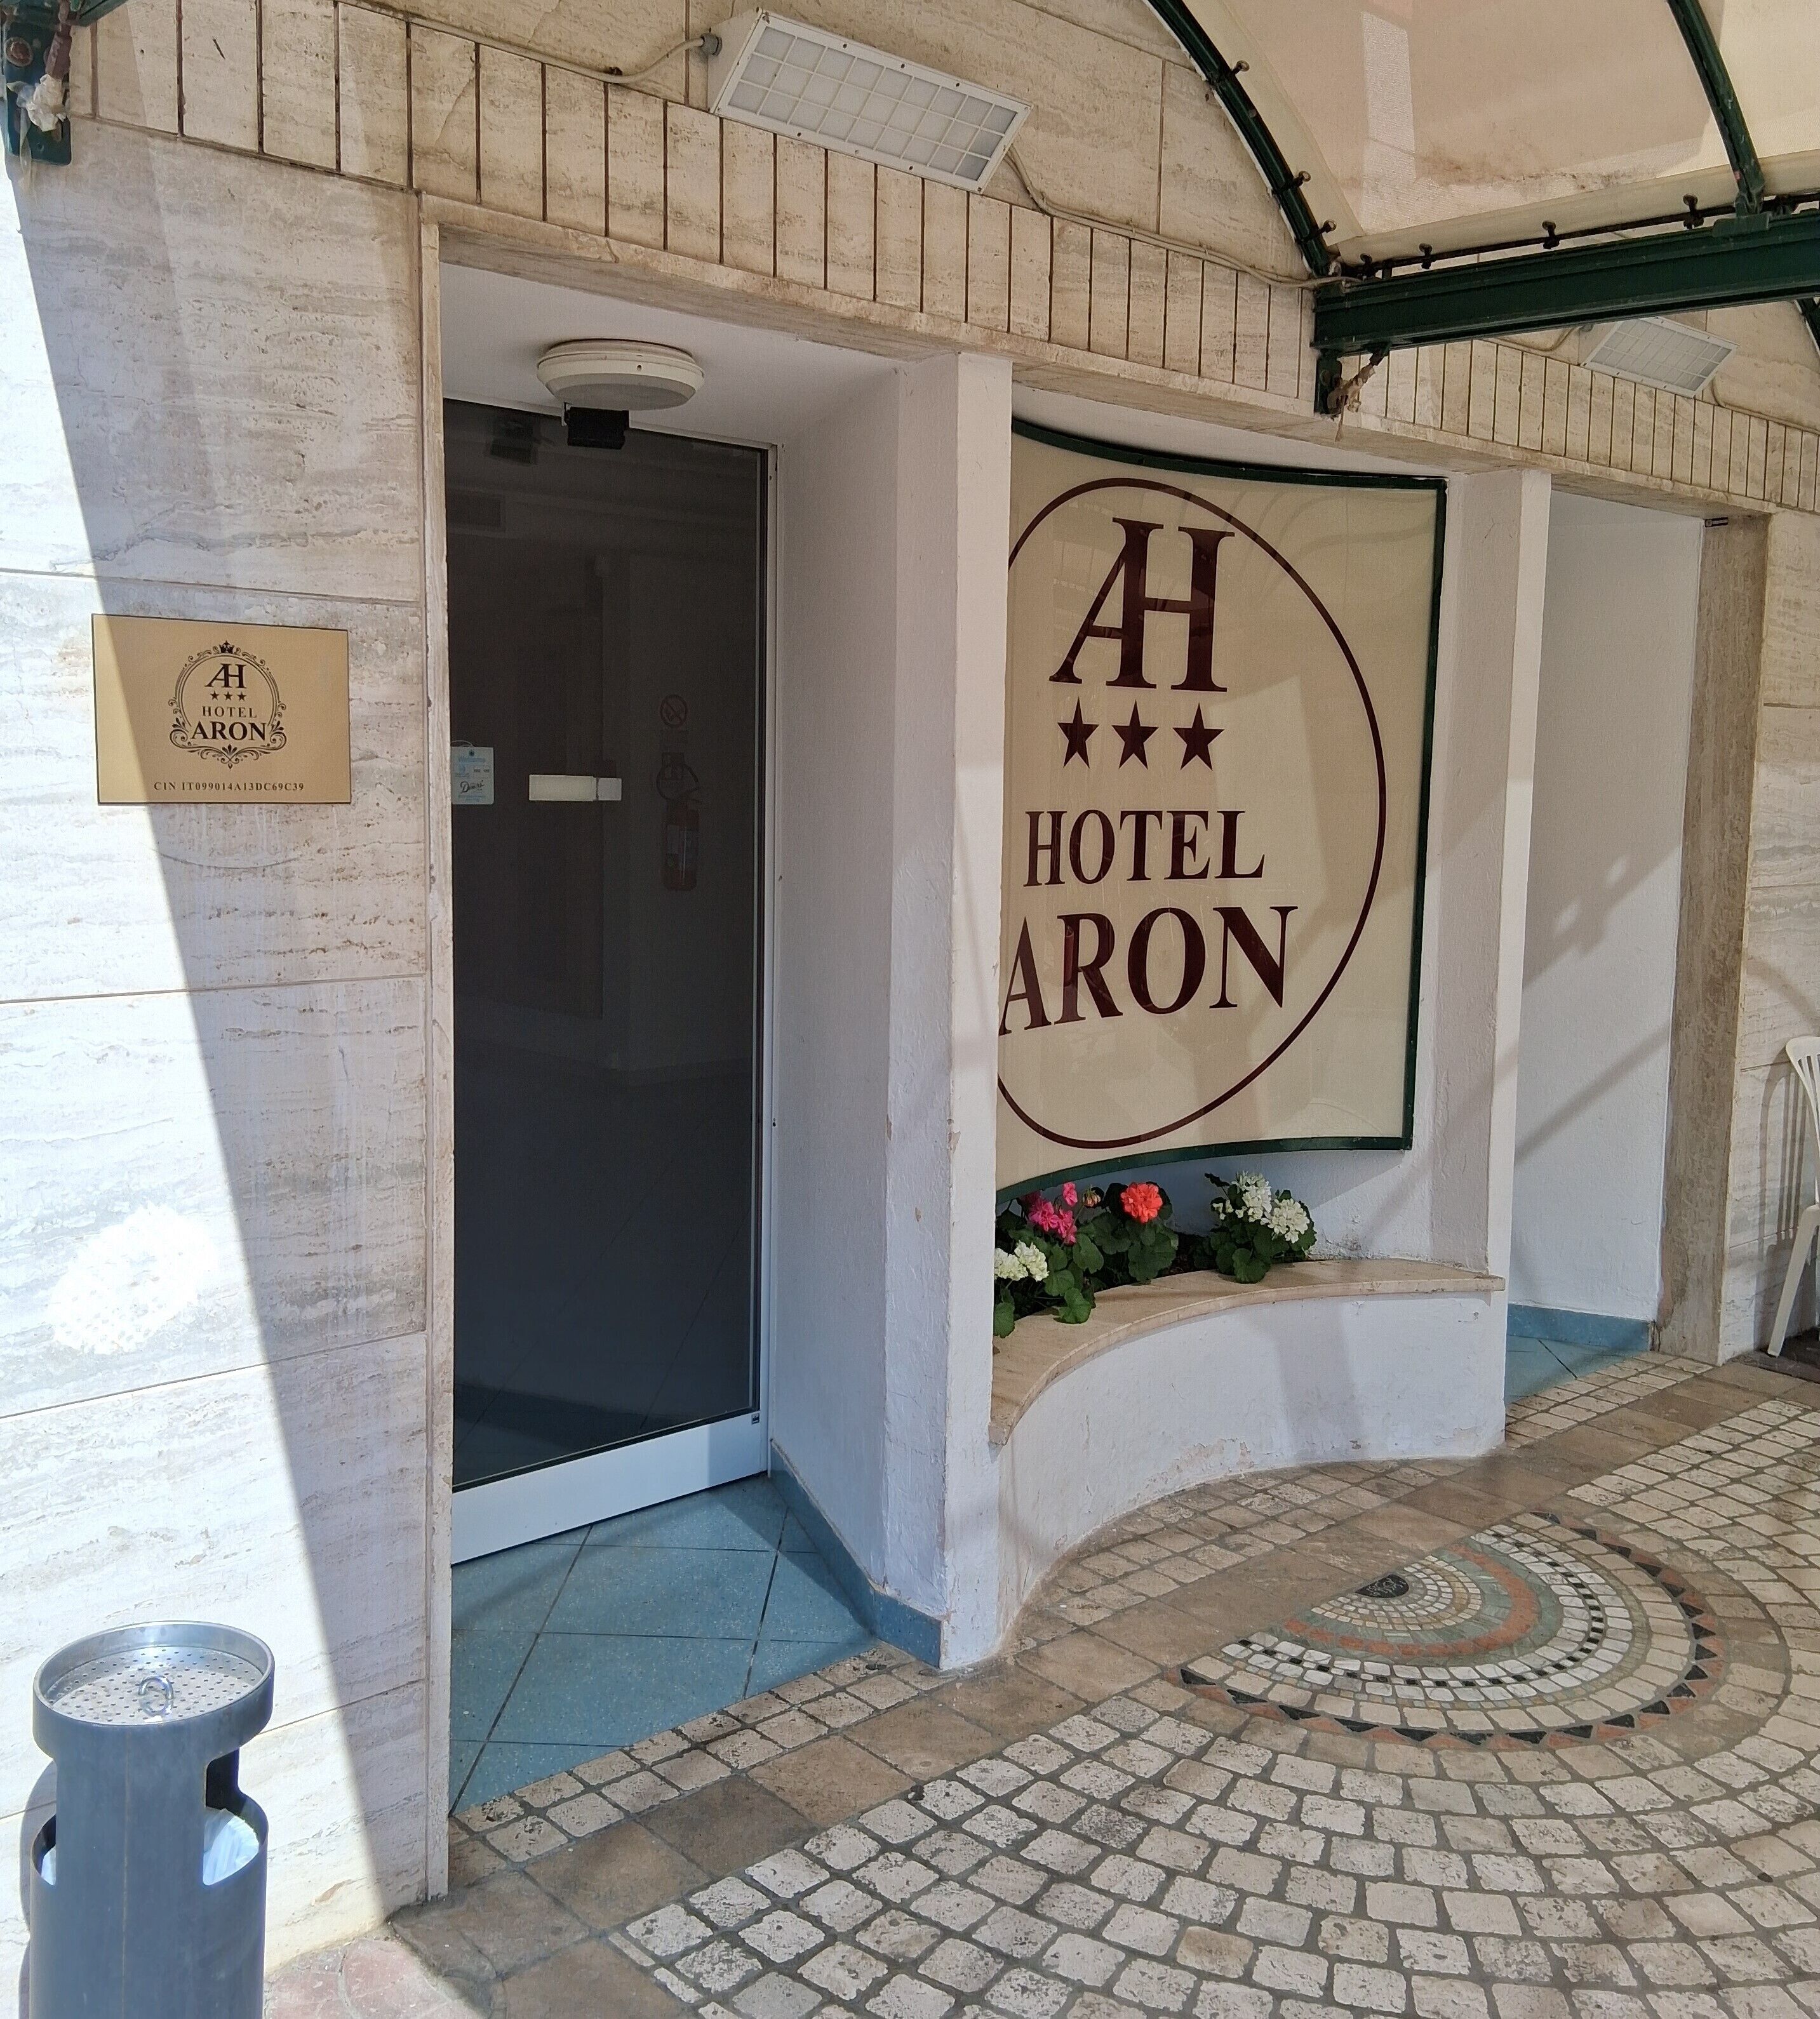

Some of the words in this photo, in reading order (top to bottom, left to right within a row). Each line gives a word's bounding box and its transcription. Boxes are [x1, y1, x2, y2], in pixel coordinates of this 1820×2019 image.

[1049, 517, 1235, 692] AH
[204, 663, 247, 689] AH
[201, 705, 258, 718] HOTEL
[191, 720, 267, 742] ARON
[154, 782, 177, 790] CIN
[1023, 810, 1266, 888] HOTEL
[998, 905, 1299, 1037] ARON
